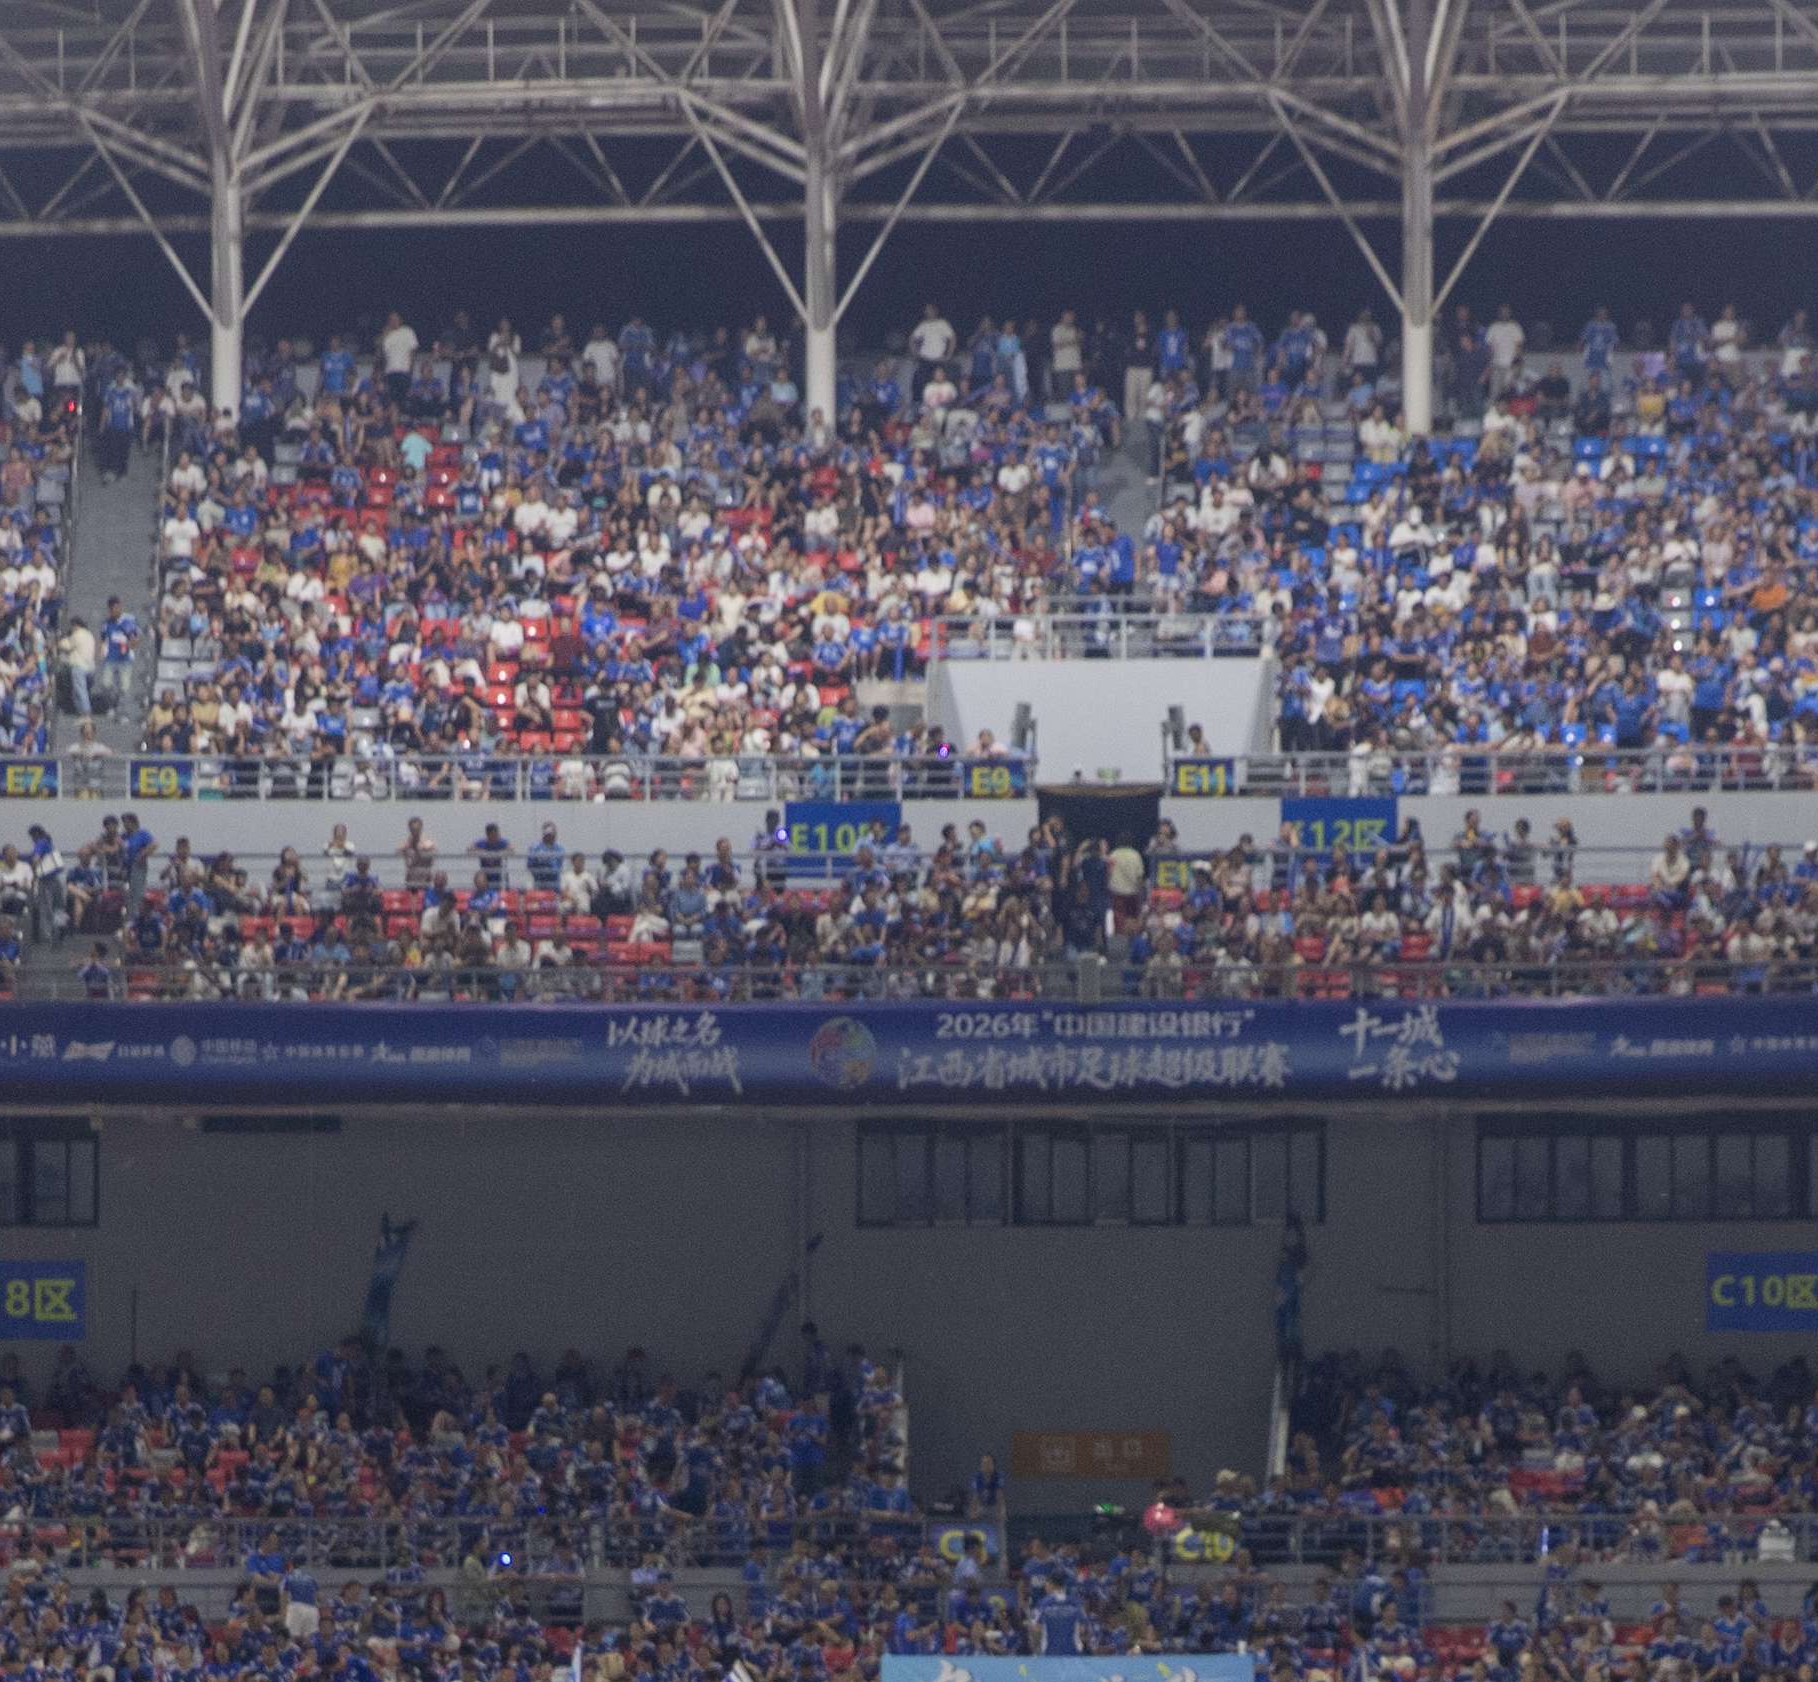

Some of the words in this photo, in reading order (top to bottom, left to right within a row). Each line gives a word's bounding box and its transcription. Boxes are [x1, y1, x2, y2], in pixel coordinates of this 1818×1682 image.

[5, 765, 45, 794] E7
[138, 766, 179, 796] E9
[971, 766, 1011, 795] E9
[1177, 764, 1227, 795] E11
[607, 1010, 722, 1047] 以球之名
[1338, 1005, 1444, 1059] 十一城
[621, 1045, 743, 1095] 为城而战
[896, 1041, 1292, 1090] 江西省城市足球超级联赛
[1711, 1273, 1818, 1310] C10区
